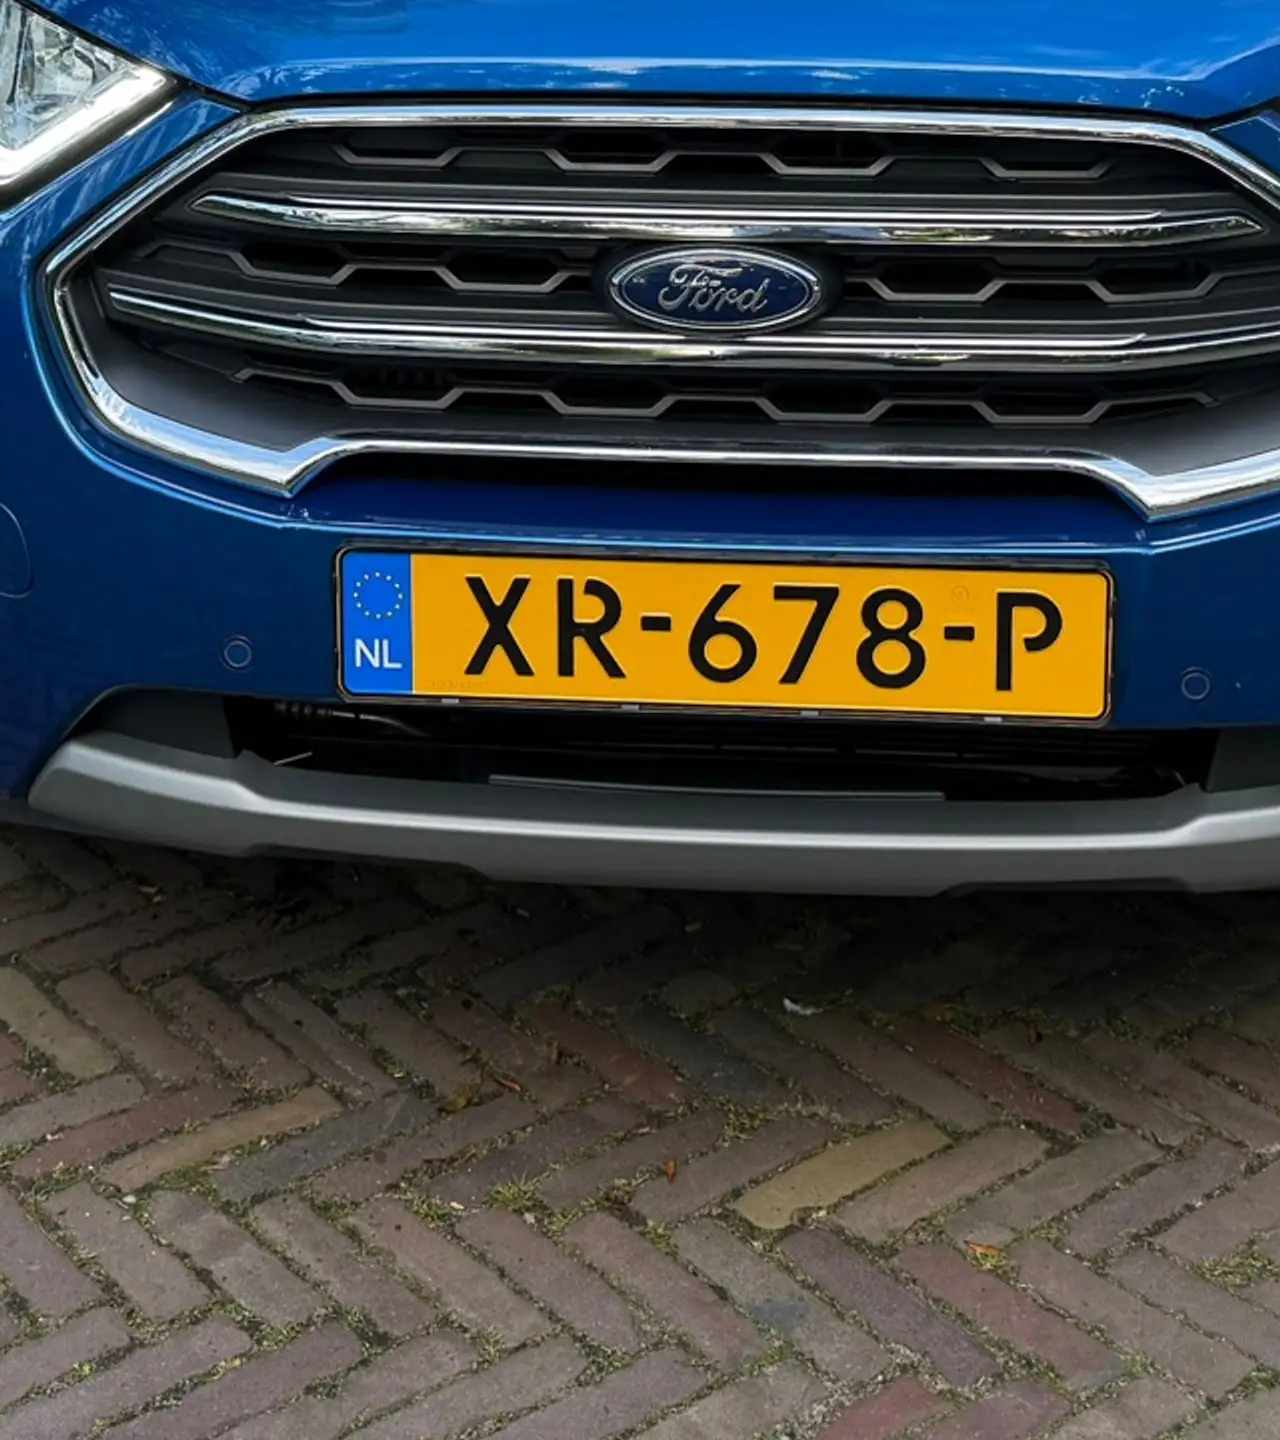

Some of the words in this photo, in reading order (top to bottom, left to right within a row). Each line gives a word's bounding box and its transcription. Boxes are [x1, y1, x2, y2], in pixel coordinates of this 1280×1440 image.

[657, 263, 770, 313] Ford
[355, 638, 403, 669] NL
[464, 575, 1063, 692] XR-678-P
